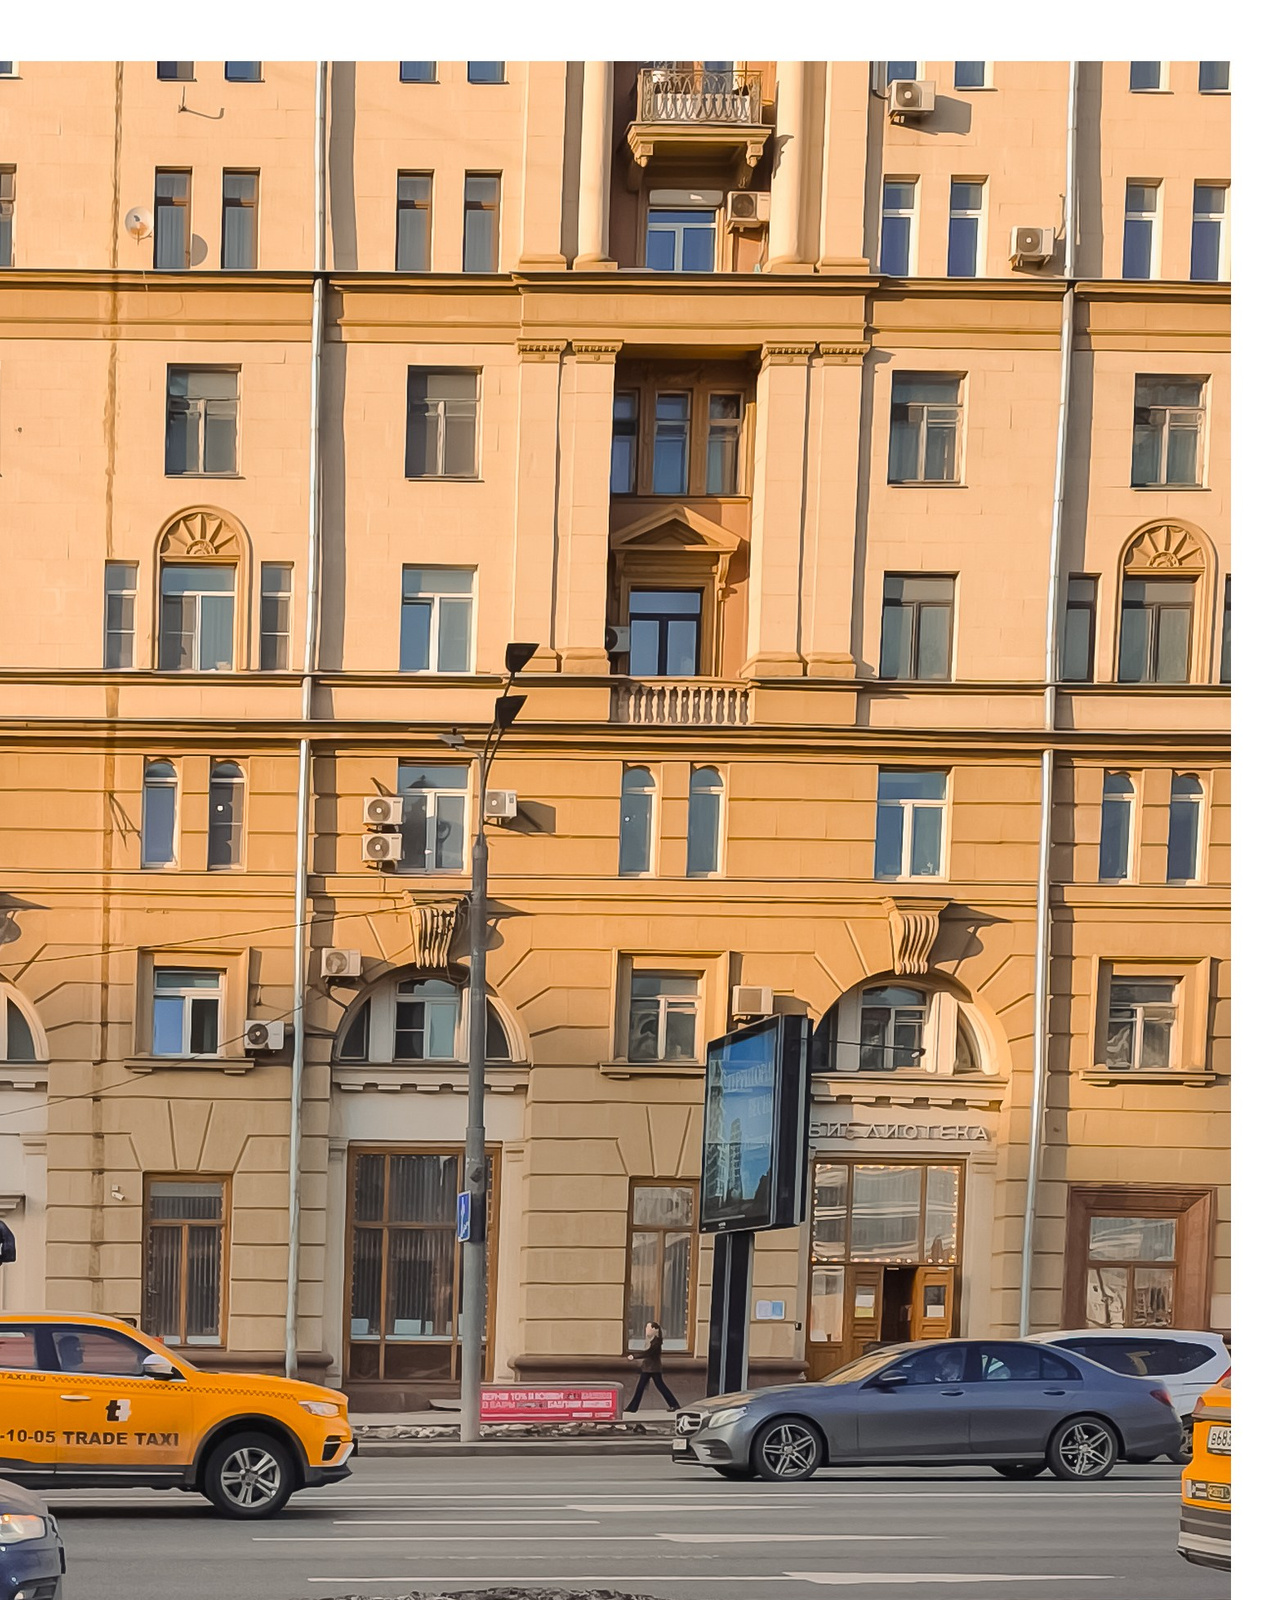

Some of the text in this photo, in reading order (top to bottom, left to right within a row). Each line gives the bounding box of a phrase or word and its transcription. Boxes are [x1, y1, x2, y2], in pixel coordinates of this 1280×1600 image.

[808, 1122, 988, 1140] БИБЛИОТЕКА
[62, 1431, 128, 1445] TRADE
[134, 1432, 179, 1447] TAXI
